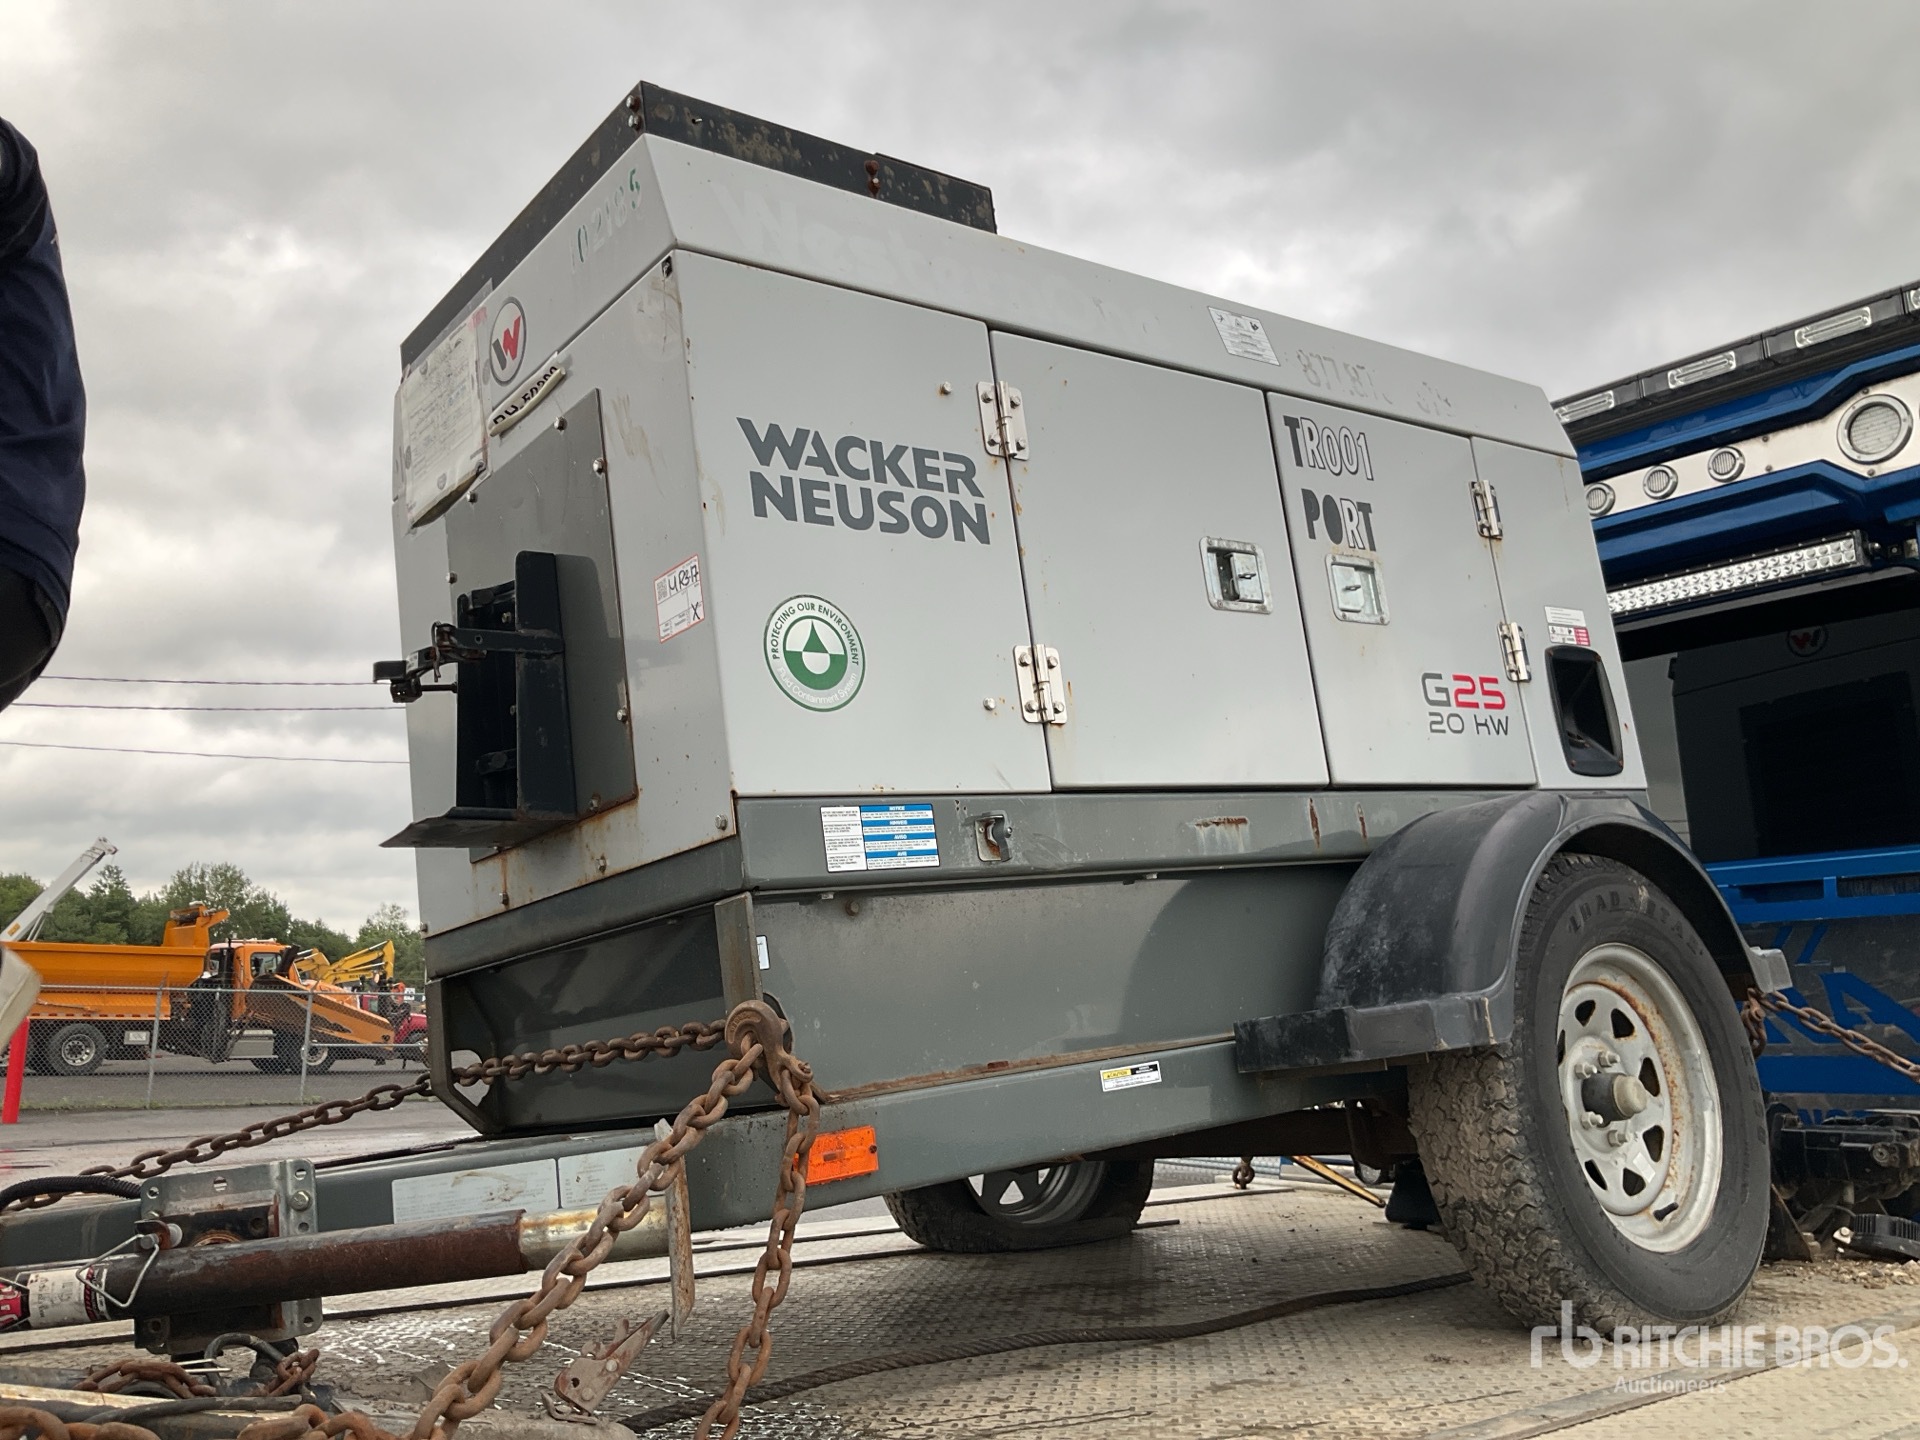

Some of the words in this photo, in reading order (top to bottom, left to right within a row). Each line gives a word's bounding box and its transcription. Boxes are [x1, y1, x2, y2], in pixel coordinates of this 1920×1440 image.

[737, 417, 986, 499] WACKER
[748, 470, 991, 545] NEUSON
[1301, 488, 1376, 552] PORT
[770, 606, 796, 660] PROTECTING
[797, 602, 816, 612] OUR
[818, 605, 859, 666] ENVIRONMENT
[1421, 672, 1506, 710] G25
[1428, 711, 1465, 734] 20
